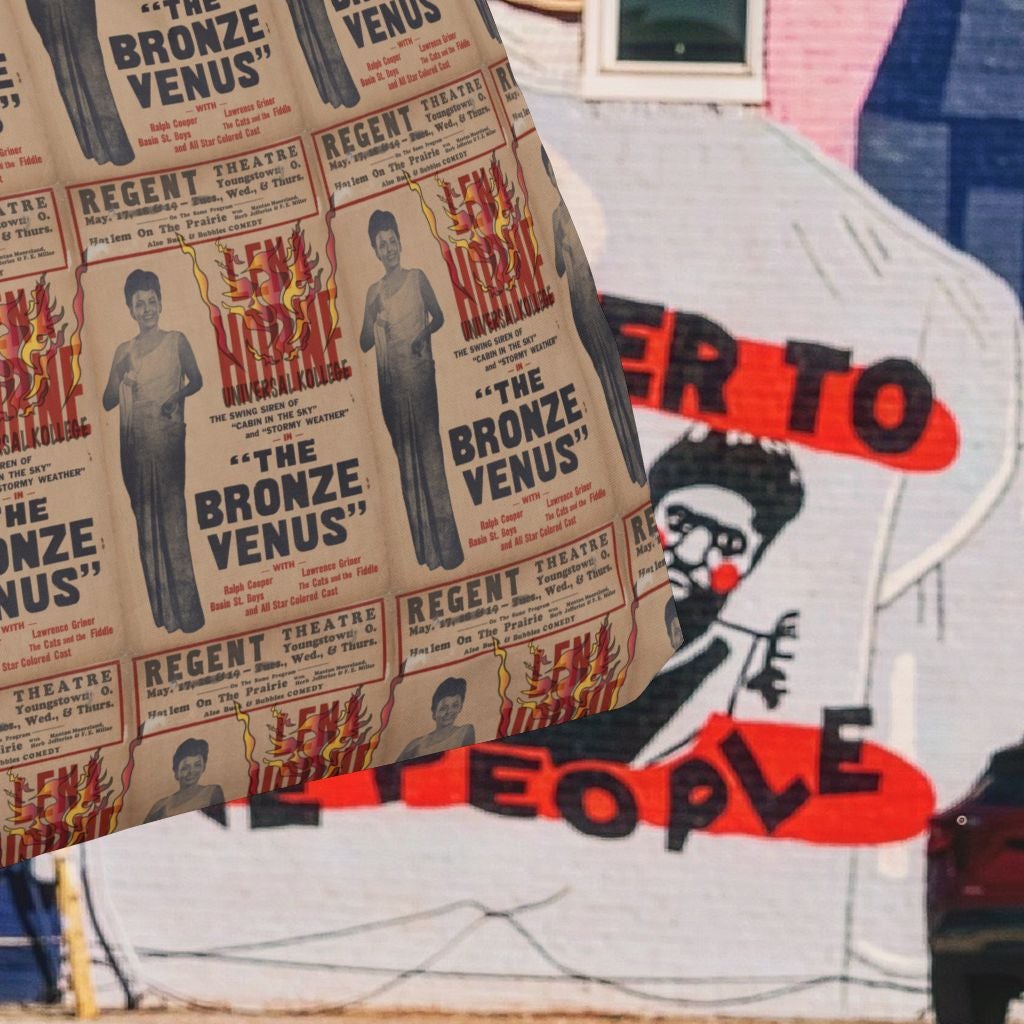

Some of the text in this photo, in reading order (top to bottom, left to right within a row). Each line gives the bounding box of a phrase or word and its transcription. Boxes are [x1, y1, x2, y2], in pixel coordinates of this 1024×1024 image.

[109, 4, 266, 70] BRONZE
[321, 79, 484, 160] REGENT THEATRE
[4, 160, 16, 169] the
[18, 154, 43, 167] Fiddle
[78, 147, 300, 215] REGENT THEATRE
[258, 181, 269, 191] &
[1, 231, 11, 241] &
[137, 213, 227, 238] On The Prairie
[785, 340, 933, 455] TO
[448, 383, 583, 466] BRONZE
[19, 455, 32, 465] OF
[7, 468, 26, 479] THE
[13, 490, 24, 500] IN
[194, 459, 362, 529] BRONZE
[407, 532, 609, 626] REGENT THEATRE
[0, 621, 25, 634] WITH
[28, 625, 114, 652] The Cats and the Fiddle
[31, 623, 69, 639] Lawrence
[1, 661, 19, 672] Star
[20, 652, 51, 668] Colored
[53, 647, 72, 660] Cast
[144, 608, 376, 687] REGENT THEATRE
[13, 670, 112, 703] THEATRE
[61, 707, 72, 717] &
